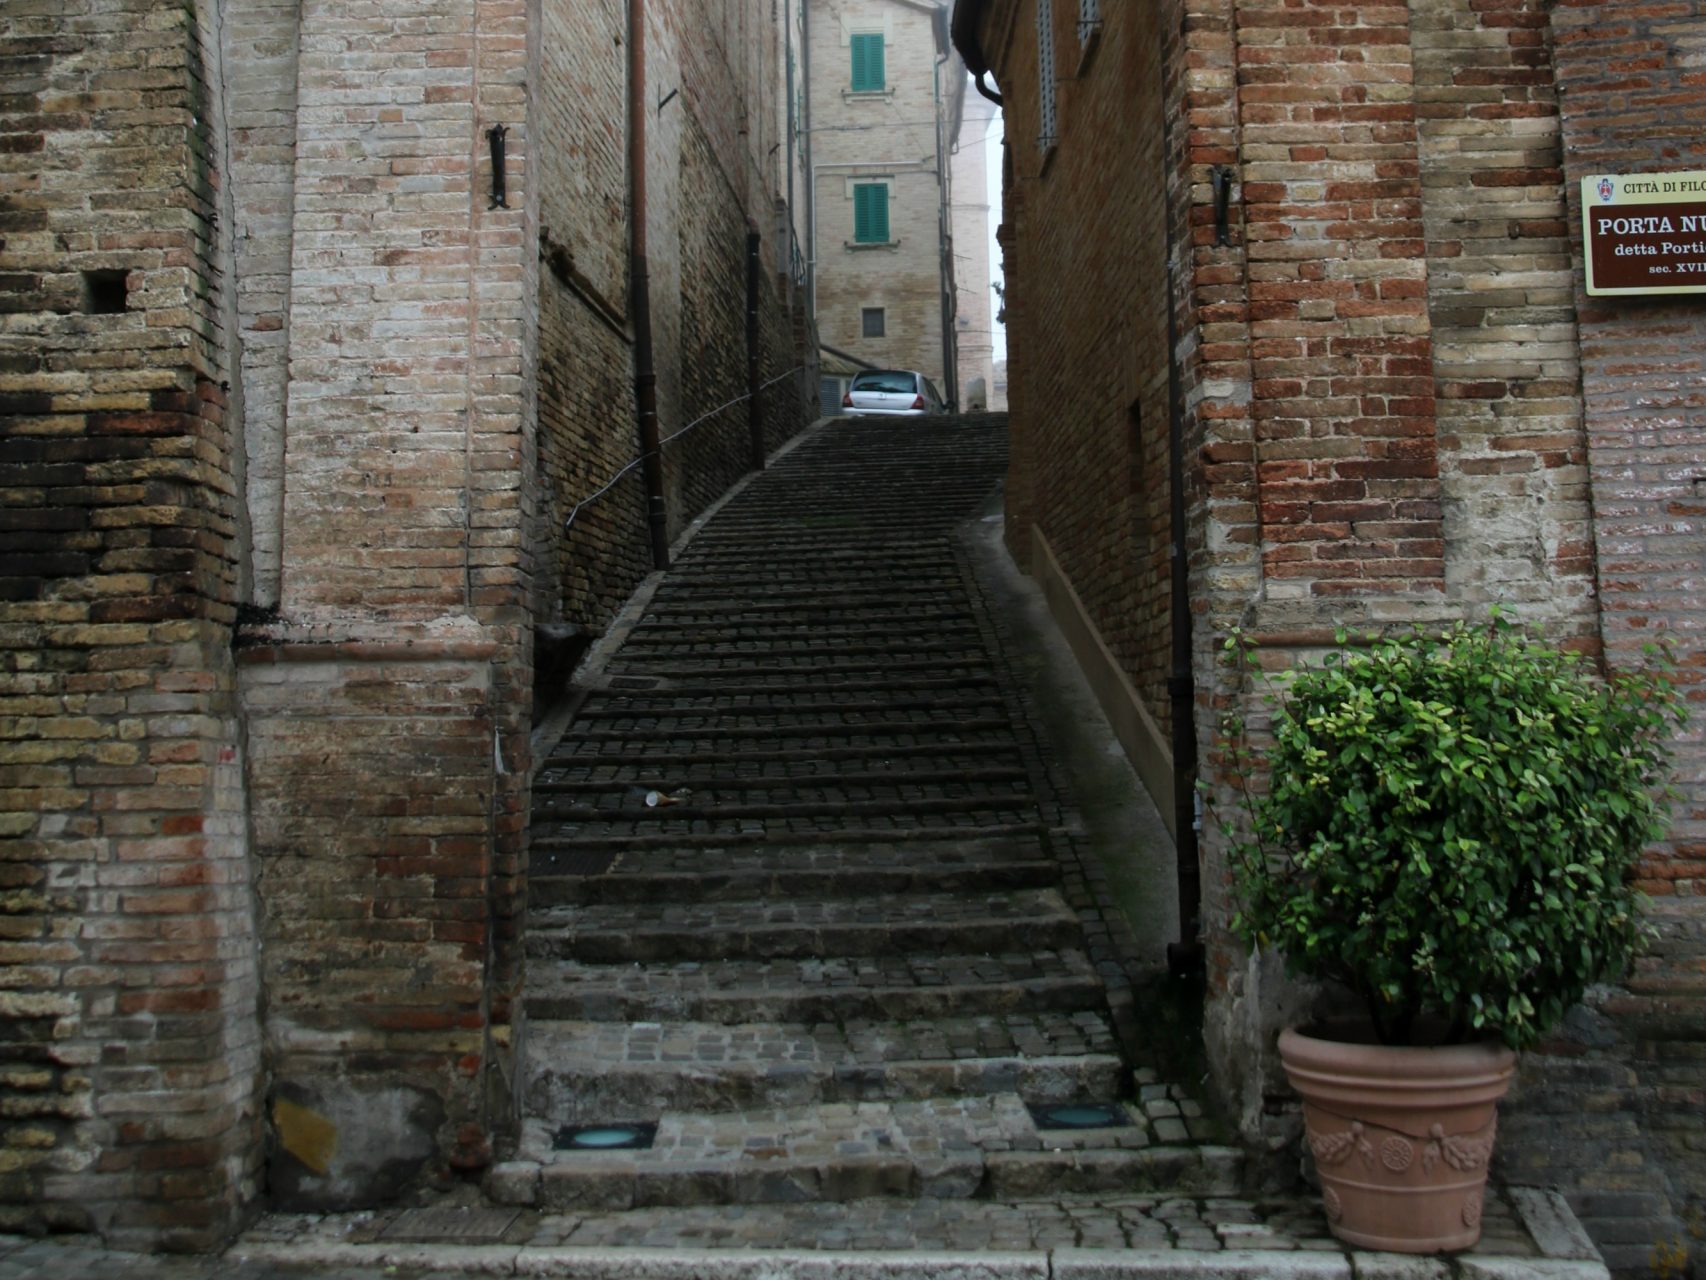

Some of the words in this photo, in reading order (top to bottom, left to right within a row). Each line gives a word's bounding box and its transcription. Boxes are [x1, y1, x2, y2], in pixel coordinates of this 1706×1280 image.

[1623, 181, 1659, 194] CITTÀ
[1663, 181, 1677, 193] DI
[1598, 216, 1675, 235] PORTA
[1615, 243, 1658, 256] detta
[1661, 241, 1706, 255] Porti
[1649, 265, 1672, 273] sec.
